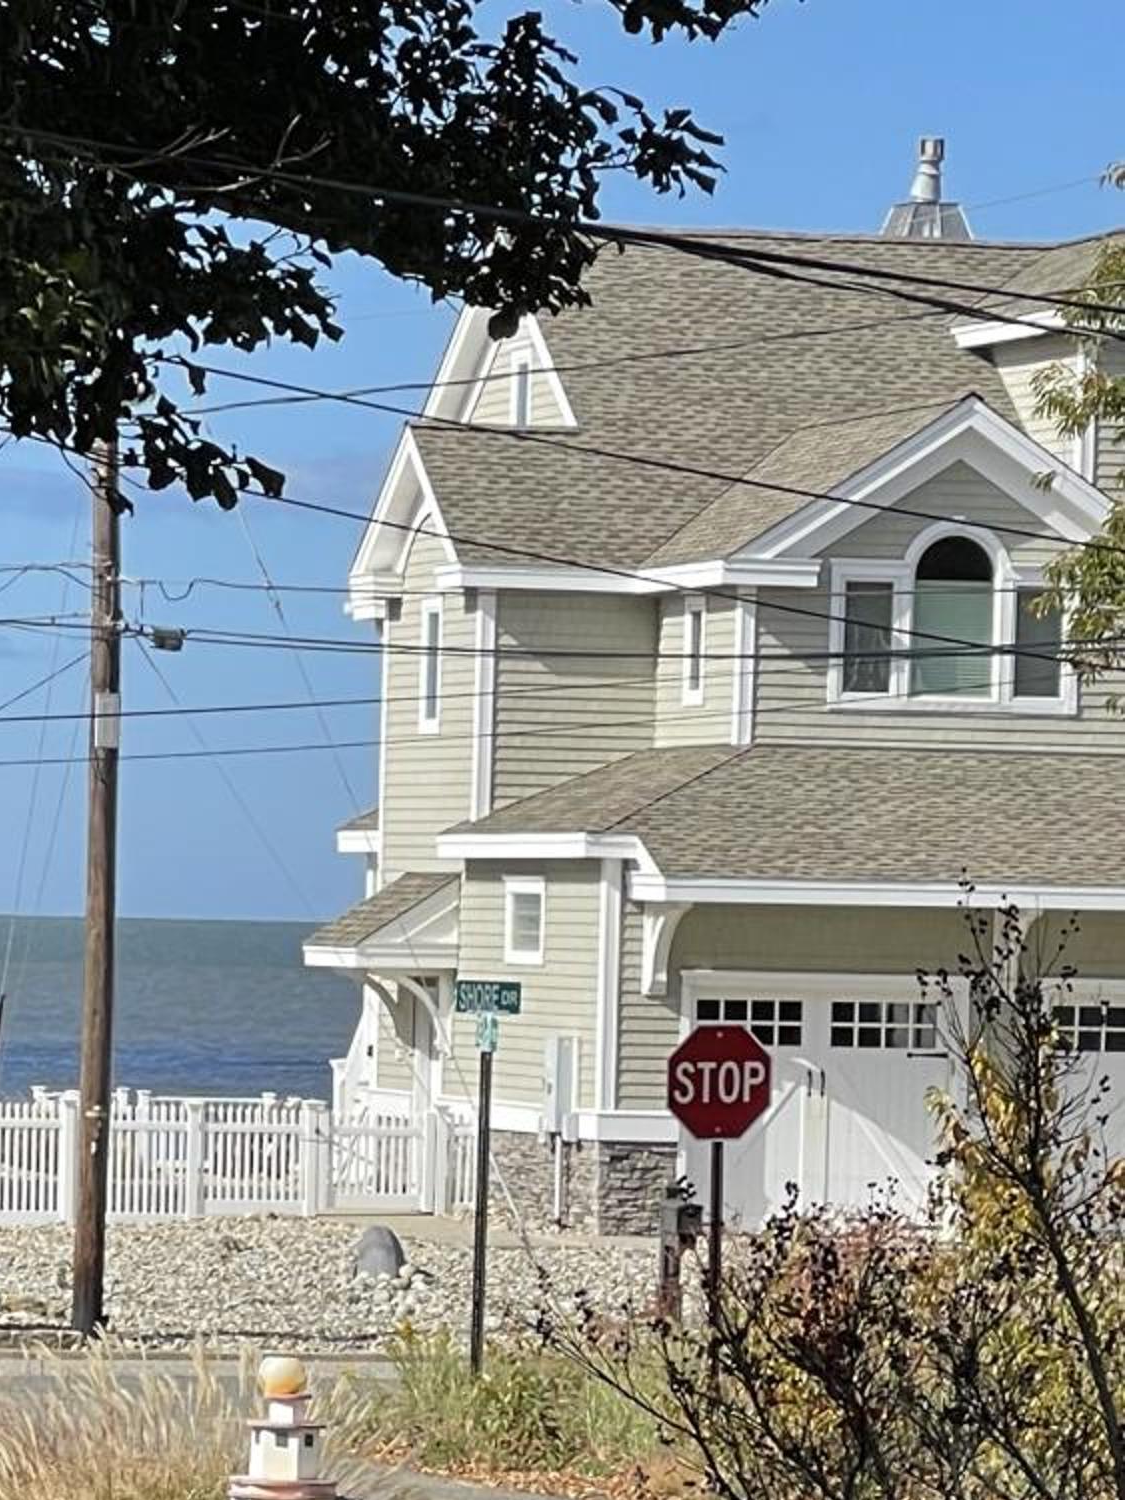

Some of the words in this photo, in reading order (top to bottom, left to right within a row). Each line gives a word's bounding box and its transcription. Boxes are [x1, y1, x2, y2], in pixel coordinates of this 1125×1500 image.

[459, 983, 500, 1010] SHORE
[500, 989, 518, 1007] DR
[673, 1061, 766, 1105] STOP
